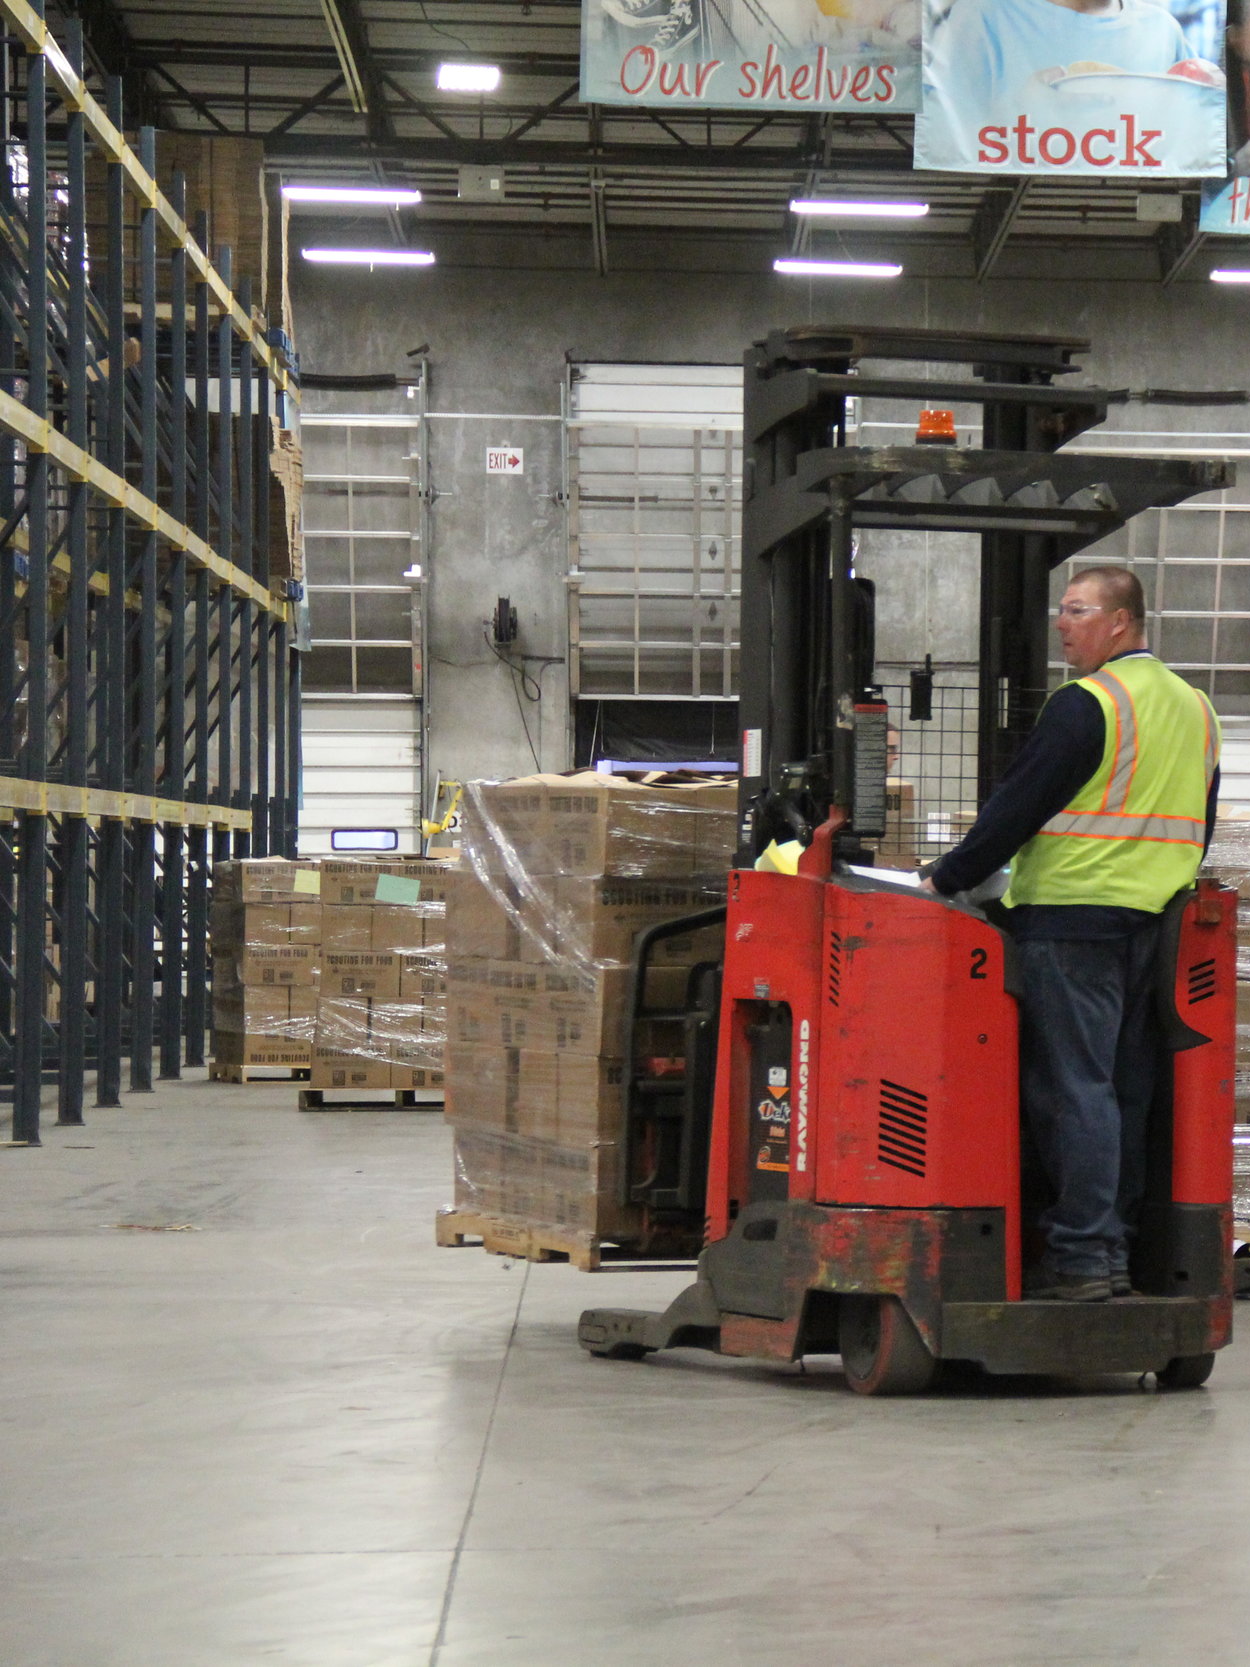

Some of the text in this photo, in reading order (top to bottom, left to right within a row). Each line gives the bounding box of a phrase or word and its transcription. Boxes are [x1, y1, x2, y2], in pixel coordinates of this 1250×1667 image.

[619, 43, 898, 103] Our shelves
[977, 113, 1163, 167] stock
[488, 452, 508, 469] EXIT
[325, 863, 358, 874] SCOUTING
[970, 948, 987, 979] 2
[796, 1019, 810, 1172] RAYMOND
